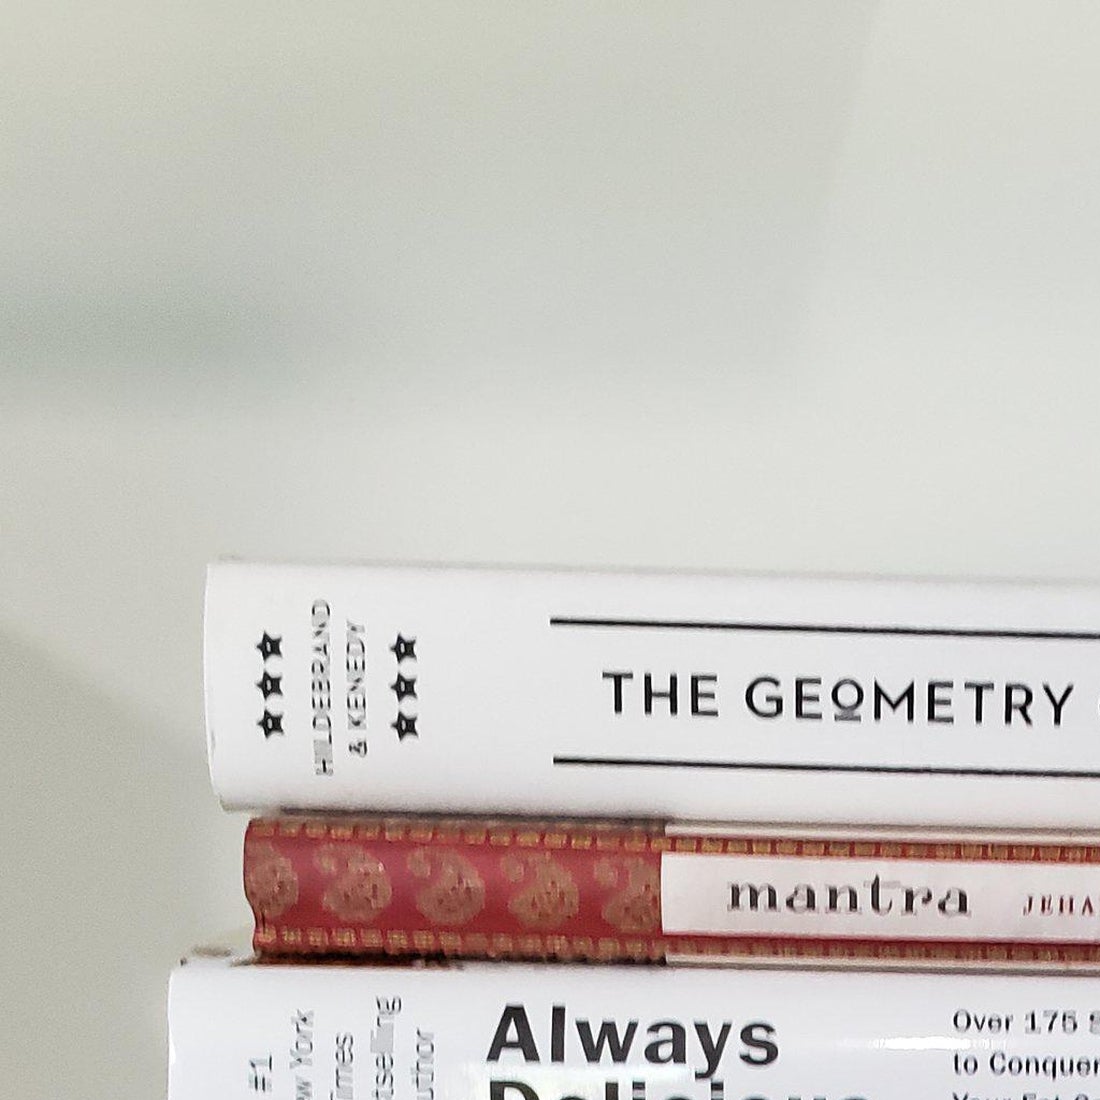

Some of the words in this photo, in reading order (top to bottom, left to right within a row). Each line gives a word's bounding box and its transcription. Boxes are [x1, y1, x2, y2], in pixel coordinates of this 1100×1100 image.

[602, 672, 718, 716] THE
[745, 675, 1073, 727] GEOMETRY
[348, 740, 367, 759] &
[727, 873, 972, 916] mantra
[290, 1009, 314, 1069] York
[486, 1003, 779, 1080] Always
[952, 1009, 1013, 1034] Over
[1025, 1010, 1078, 1035] 175
[250, 1055, 272, 1092] #1
[953, 1052, 978, 1076] to
